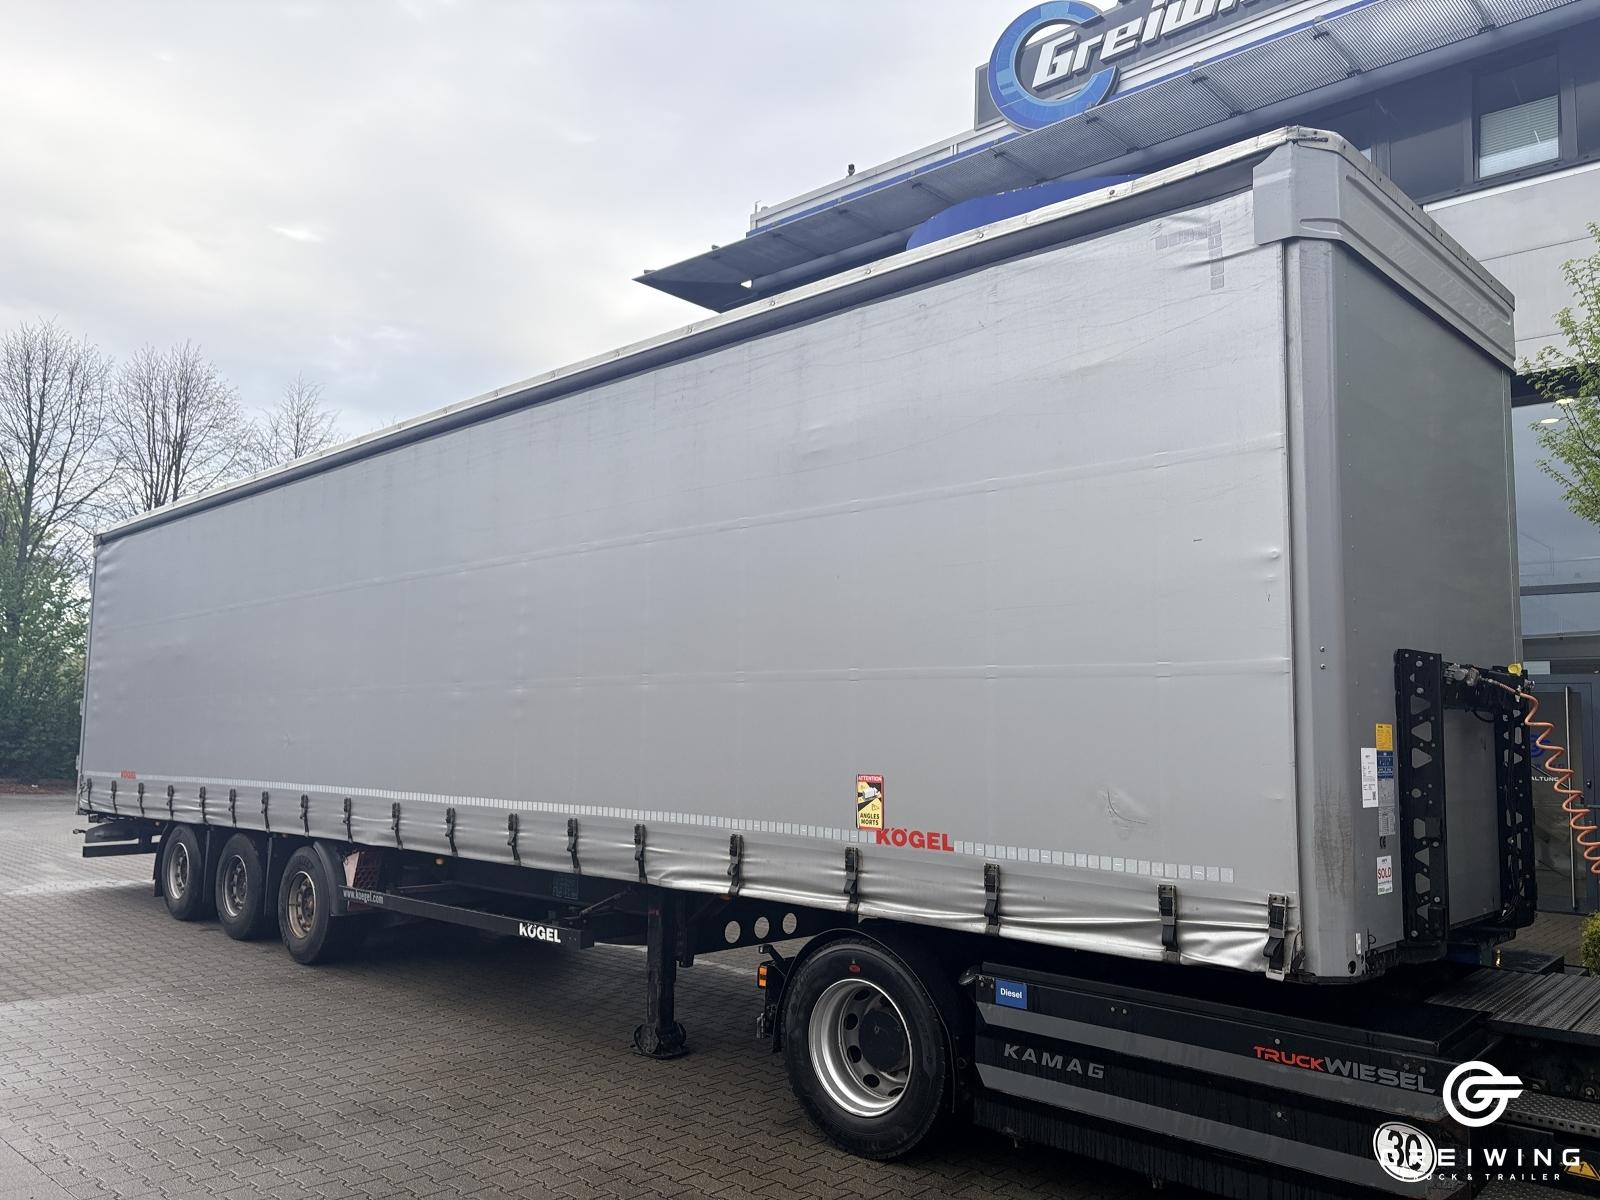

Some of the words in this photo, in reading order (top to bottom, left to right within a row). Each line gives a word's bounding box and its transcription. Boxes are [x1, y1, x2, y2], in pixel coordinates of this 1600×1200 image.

[876, 826, 955, 852] KÖGEL
[1377, 867, 1392, 880] SOLD
[519, 922, 562, 943] KÖGEL
[1000, 987, 1023, 999] Diesel
[1003, 1043, 1105, 1079] KAMAG
